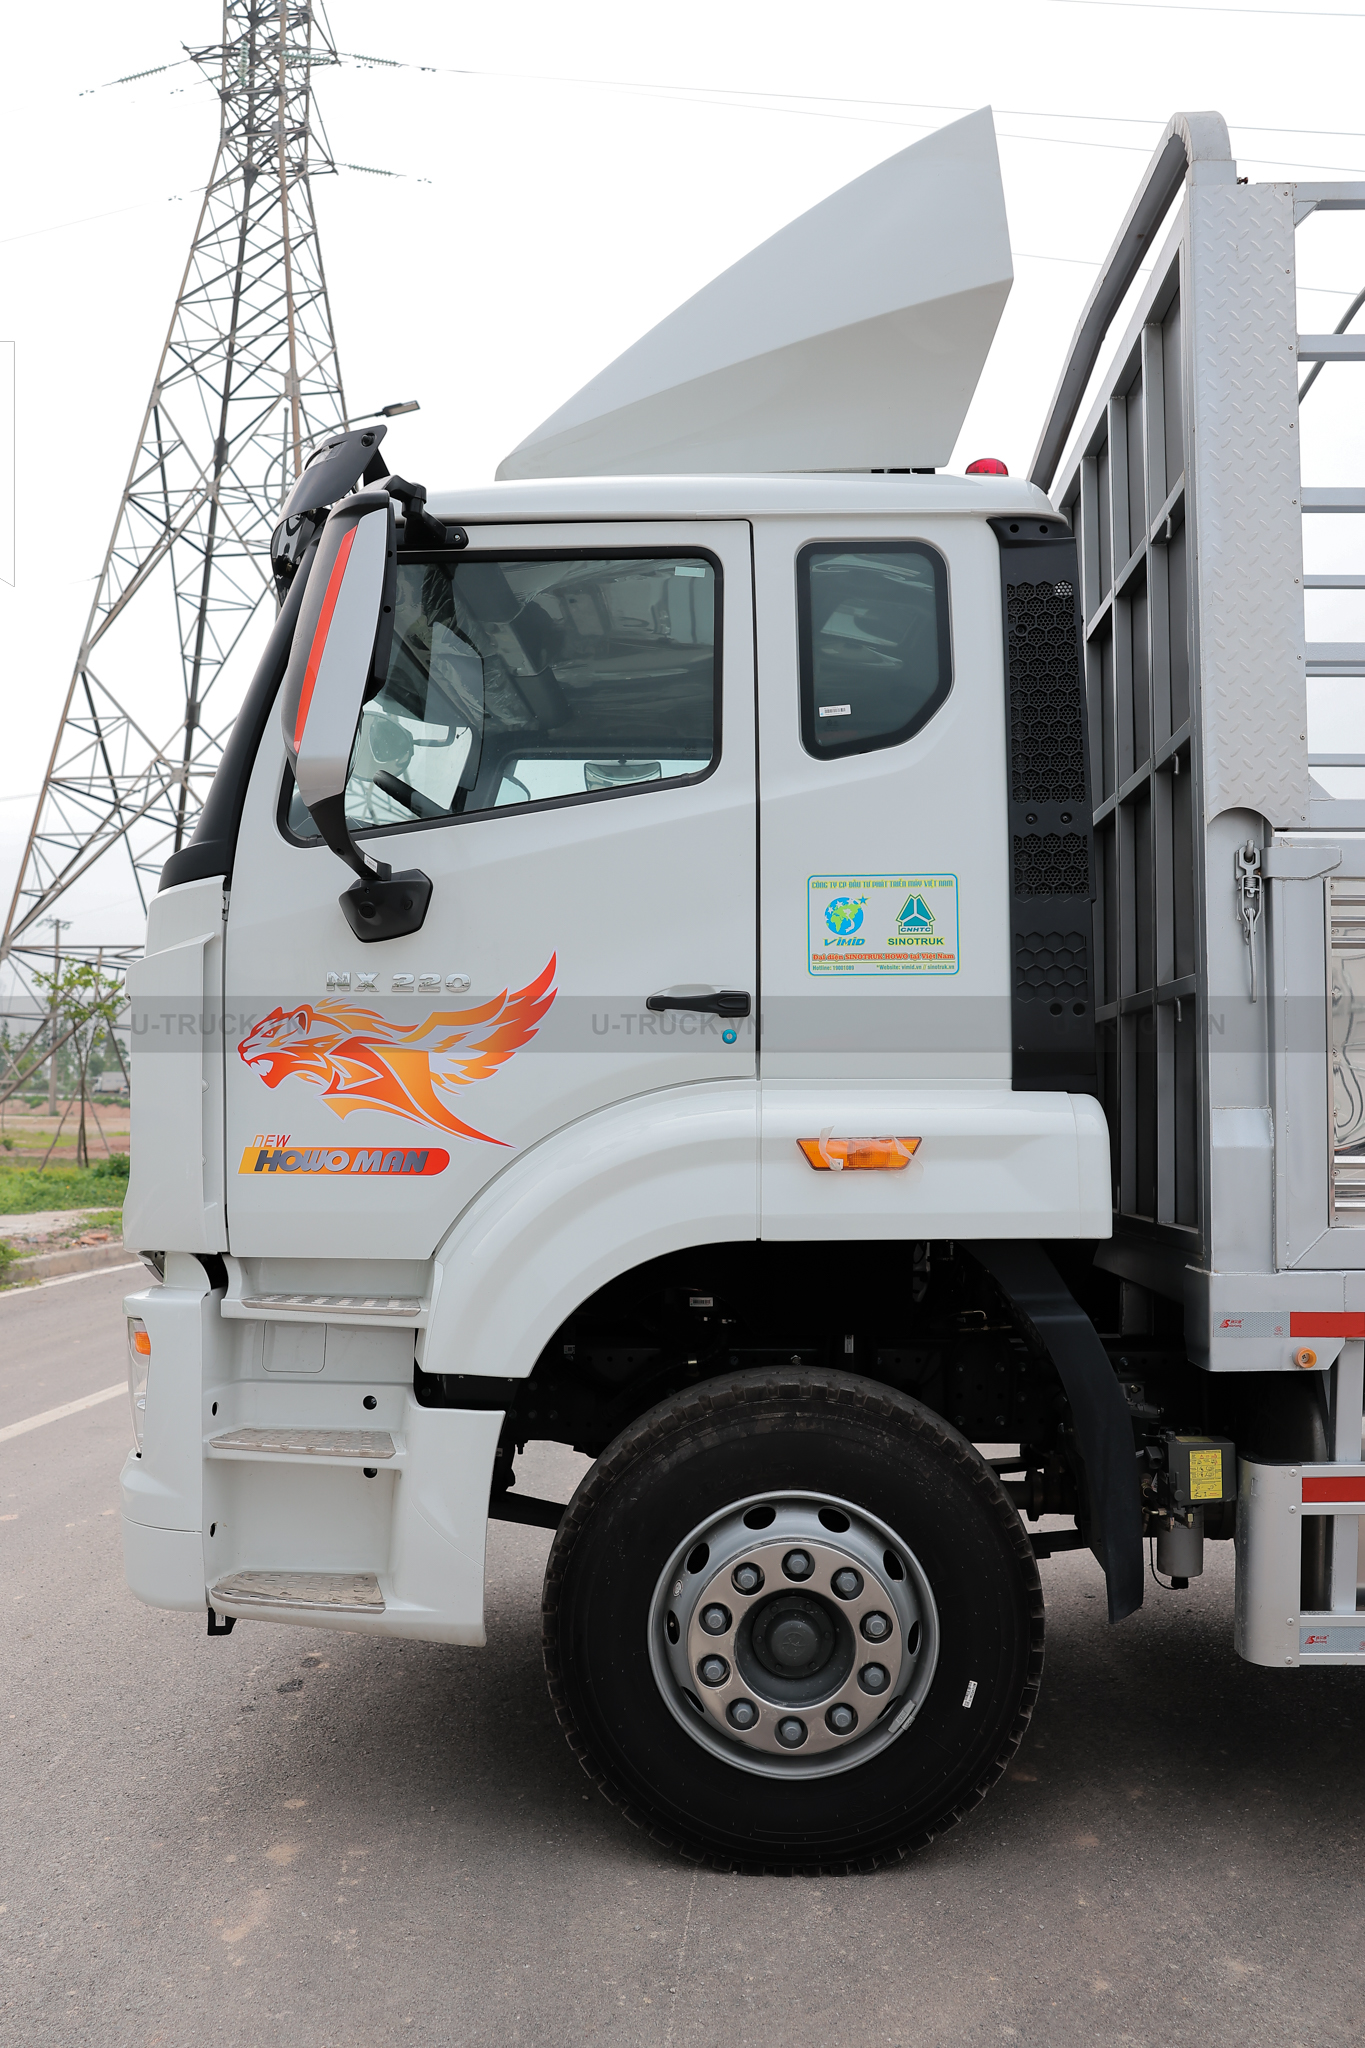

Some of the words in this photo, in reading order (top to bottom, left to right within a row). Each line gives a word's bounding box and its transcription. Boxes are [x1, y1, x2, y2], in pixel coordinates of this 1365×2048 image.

[887, 937, 944, 946] SINOTRUK
[326, 971, 380, 992] NX
[391, 972, 471, 993] 220
[254, 1149, 350, 1172] HOWO
[351, 1149, 429, 1173] MAN
